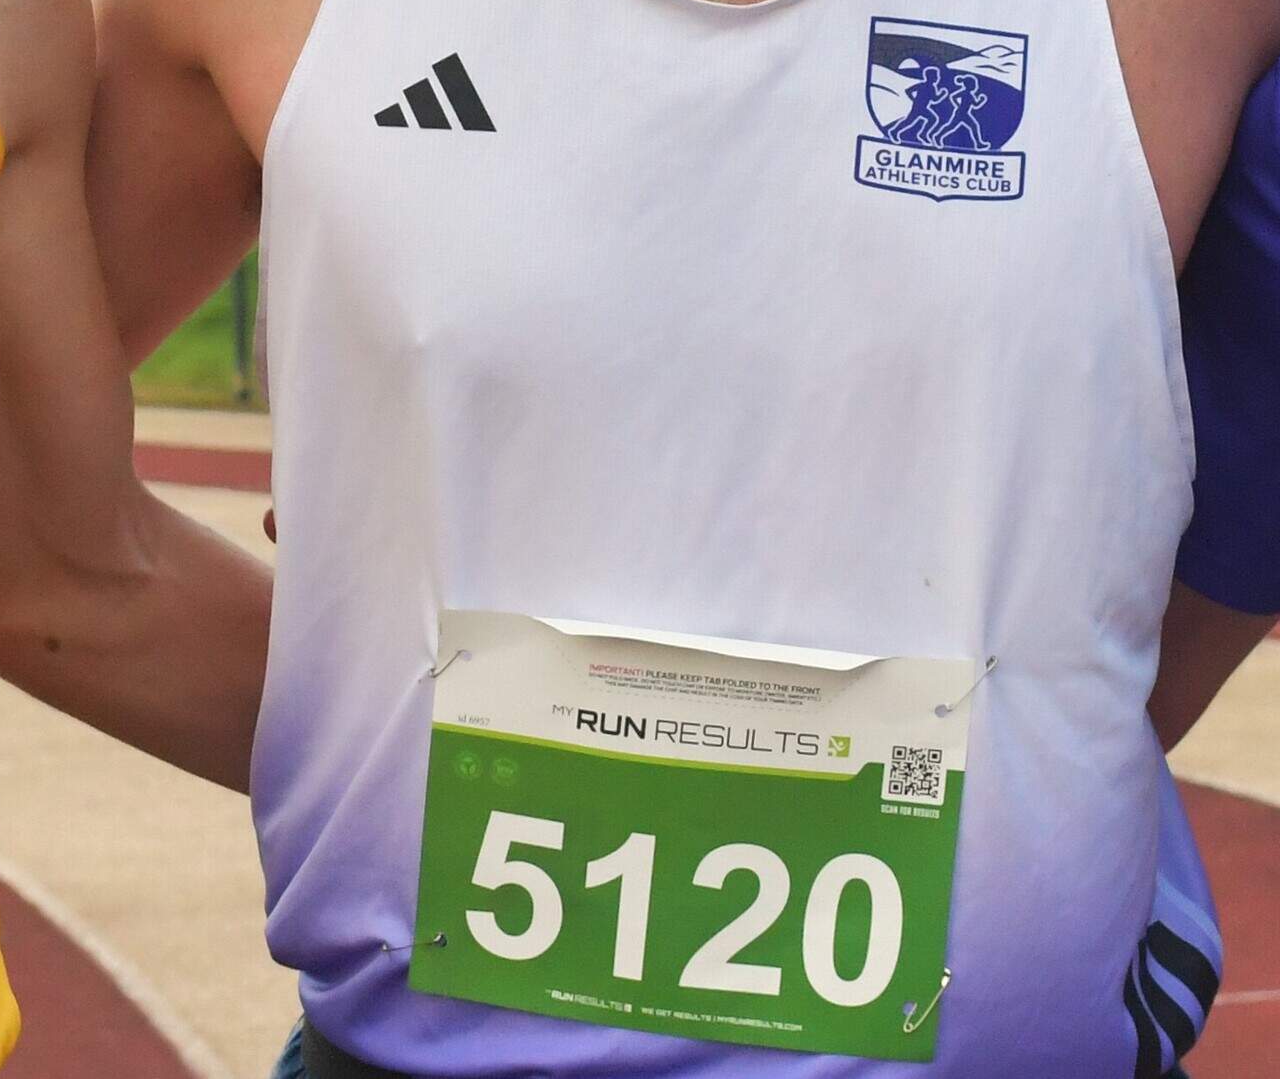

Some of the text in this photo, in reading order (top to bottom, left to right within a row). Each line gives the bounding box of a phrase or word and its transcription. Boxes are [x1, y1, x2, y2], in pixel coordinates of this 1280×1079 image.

[875, 149, 1005, 178] GLANMIRE
[865, 166, 1011, 192] ATHLETICS CLUB
[646, 670, 677, 680] PLEASE
[680, 673, 702, 683] KEEP
[704, 676, 720, 685] TAB
[722, 678, 757, 689] FOLDED
[760, 682, 771, 690] TO
[774, 683, 789, 692] THE
[791, 685, 821, 695] FRONT
[552, 704, 819, 756] MY RUN RESULTS
[465, 810, 903, 1007] 5120
